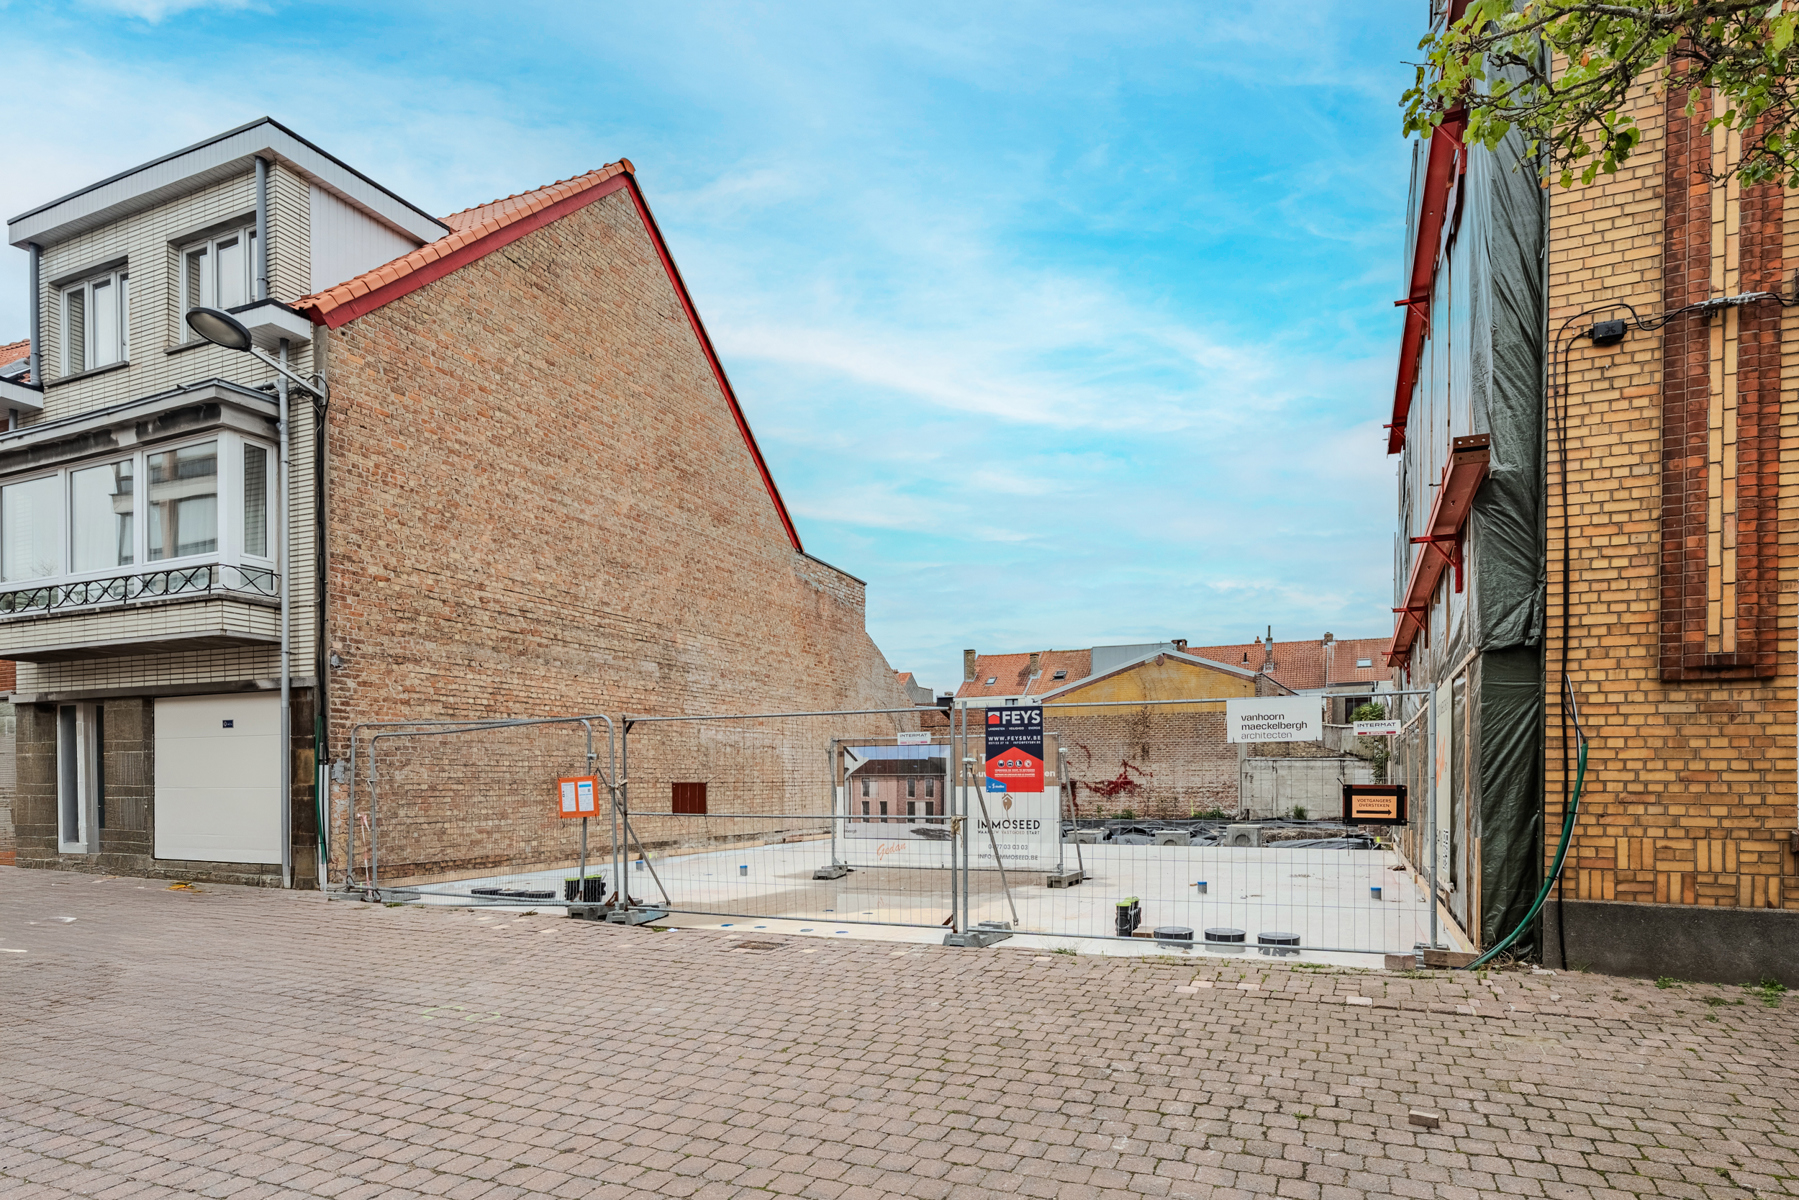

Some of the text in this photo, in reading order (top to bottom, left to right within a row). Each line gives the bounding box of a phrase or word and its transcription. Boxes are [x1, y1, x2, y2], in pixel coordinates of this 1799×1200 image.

[1002, 710, 1041, 724] FEYS
[1241, 713, 1285, 721] vanhoorn
[1241, 721, 1308, 731] maeckelbergh
[1241, 731, 1293, 740] architecten
